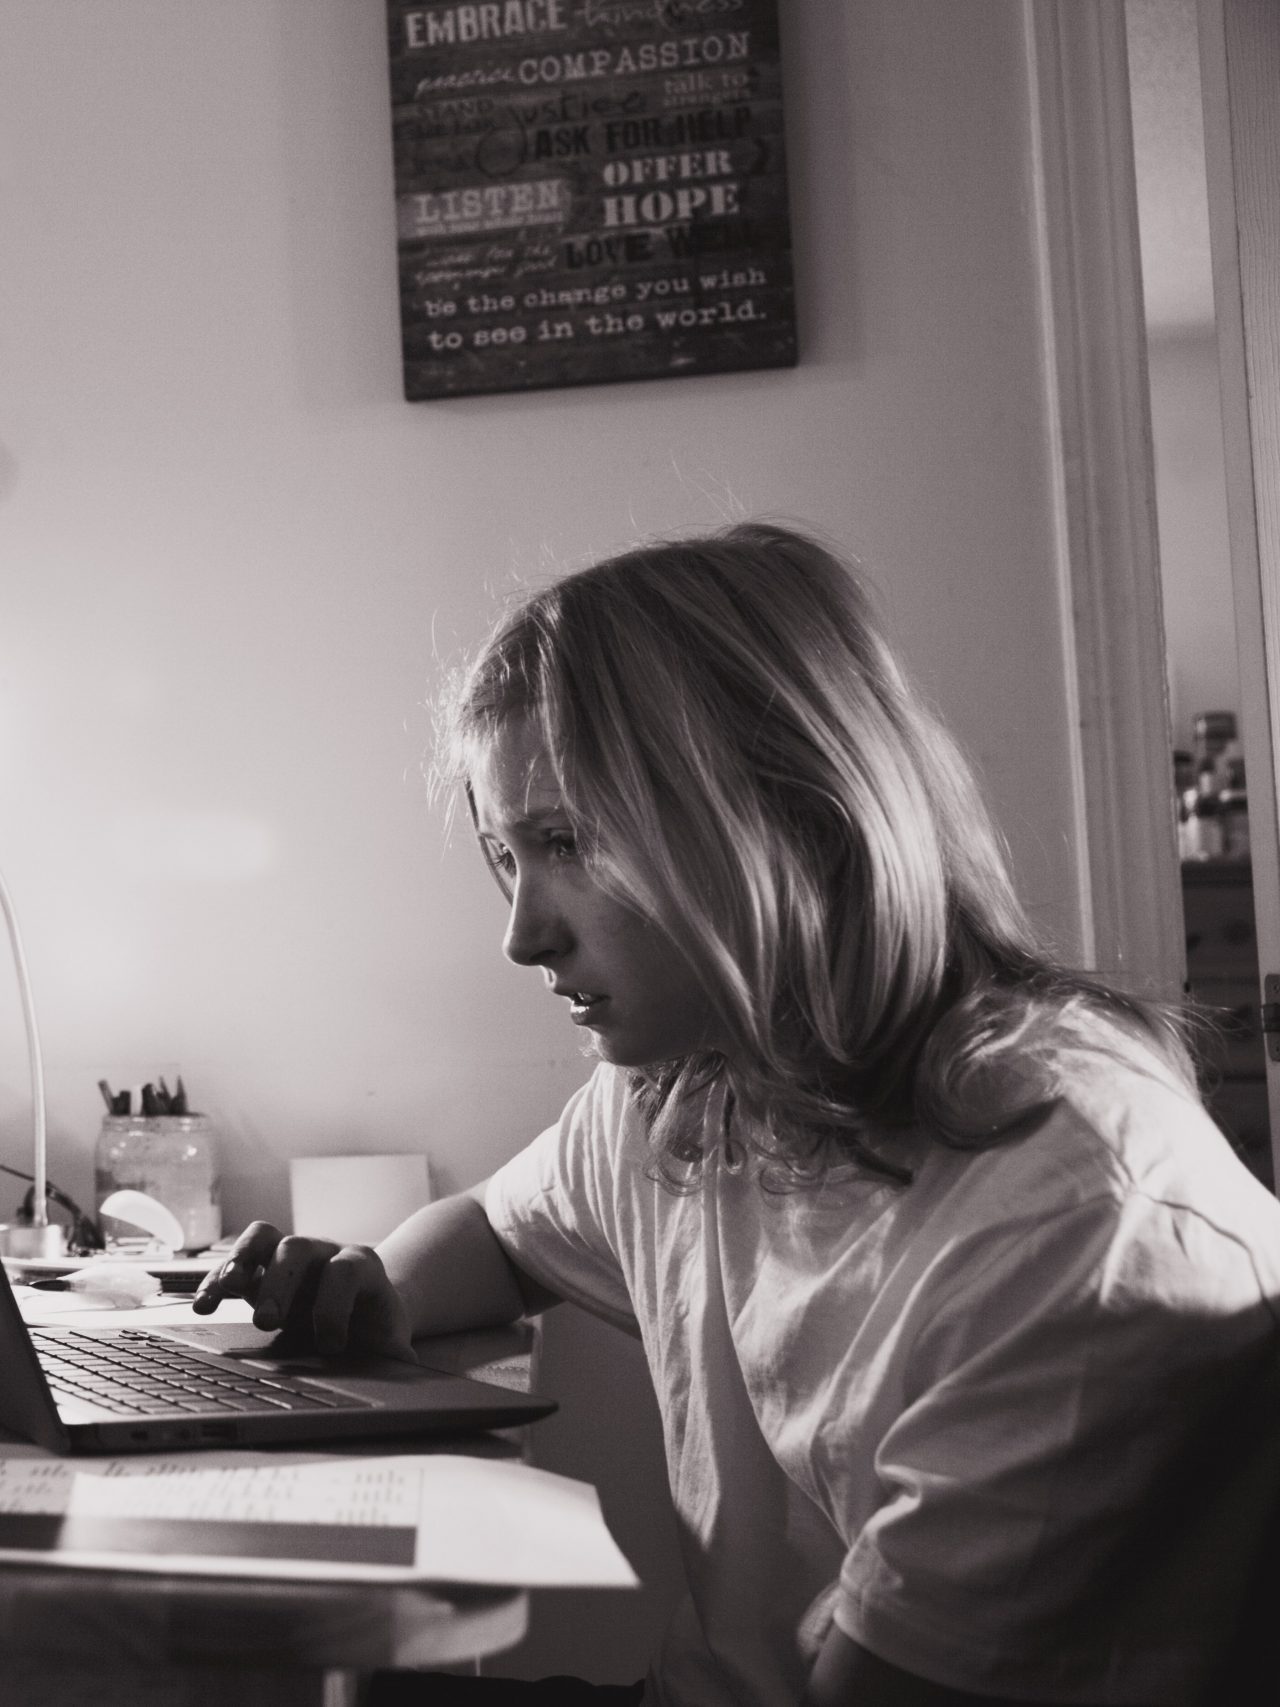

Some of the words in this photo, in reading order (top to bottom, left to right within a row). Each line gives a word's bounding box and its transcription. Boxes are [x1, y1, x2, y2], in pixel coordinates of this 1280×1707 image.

[405, 0, 568, 50] EMBRACE
[518, 31, 752, 85] COMPASSION
[534, 126, 590, 161] ASK
[605, 117, 662, 154] FOR
[675, 106, 752, 145] HELP
[602, 149, 734, 188] OFFER
[413, 178, 561, 224] LISTEN
[602, 182, 741, 229] HOPE
[565, 234, 652, 270] LOVE
[425, 299, 458, 318] be
[467, 293, 516, 313] the
[523, 283, 628, 310] change
[635, 277, 691, 301] you
[699, 267, 768, 290] wish
[427, 330, 464, 350] to
[472, 325, 528, 347] see
[537, 318, 575, 341] in
[584, 313, 645, 338] the
[655, 298, 769, 330] world.
